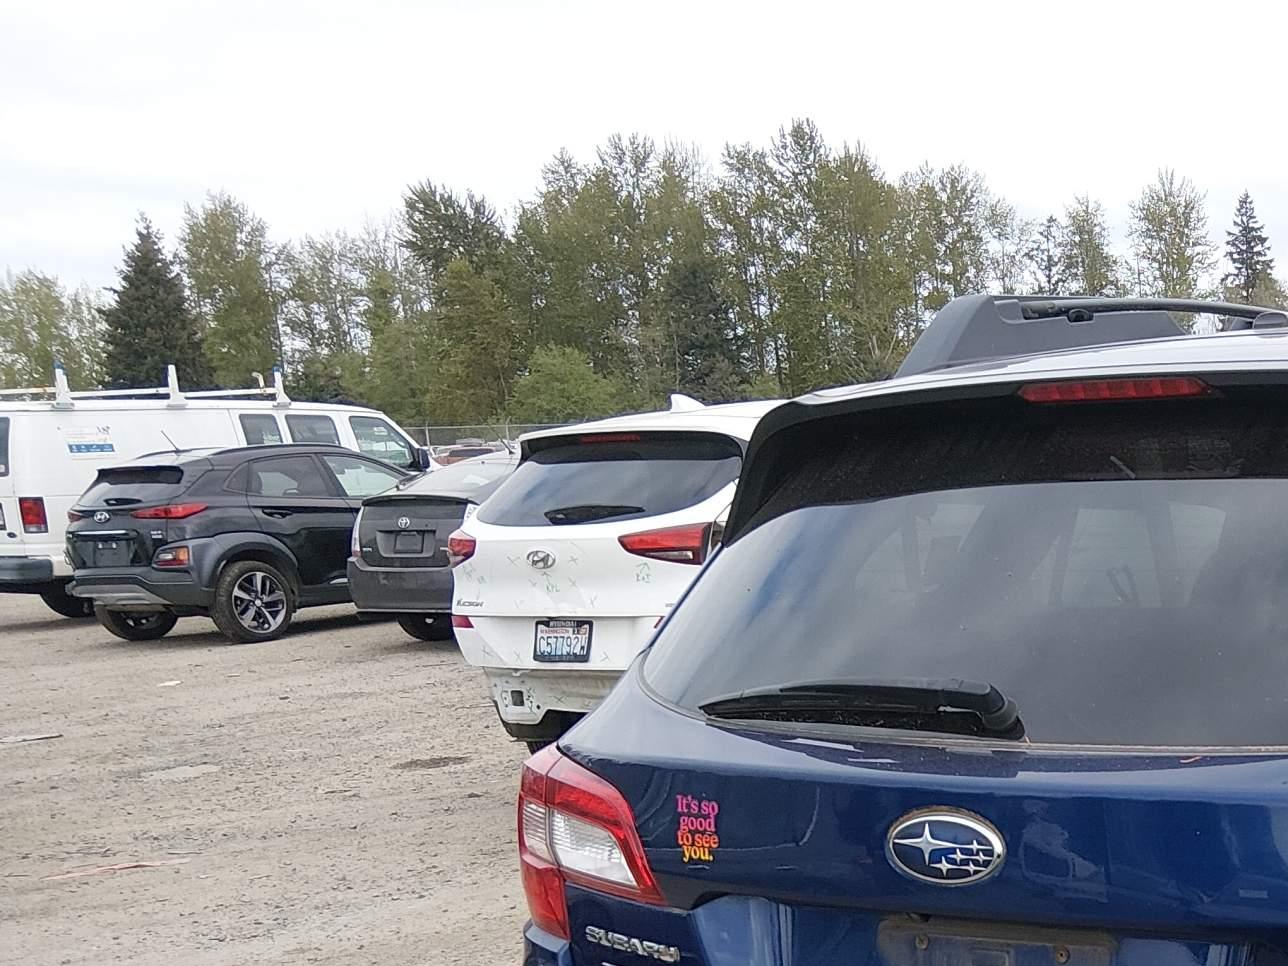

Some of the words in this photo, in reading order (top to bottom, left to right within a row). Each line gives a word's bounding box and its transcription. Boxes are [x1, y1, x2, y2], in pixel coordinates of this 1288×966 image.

[676, 795, 699, 813] It's
[701, 800, 719, 815] so
[680, 814, 715, 832] good
[678, 830, 692, 846] to
[694, 833, 719, 848] see
[682, 845, 713, 862] you.
[586, 926, 680, 962] SUBARU
